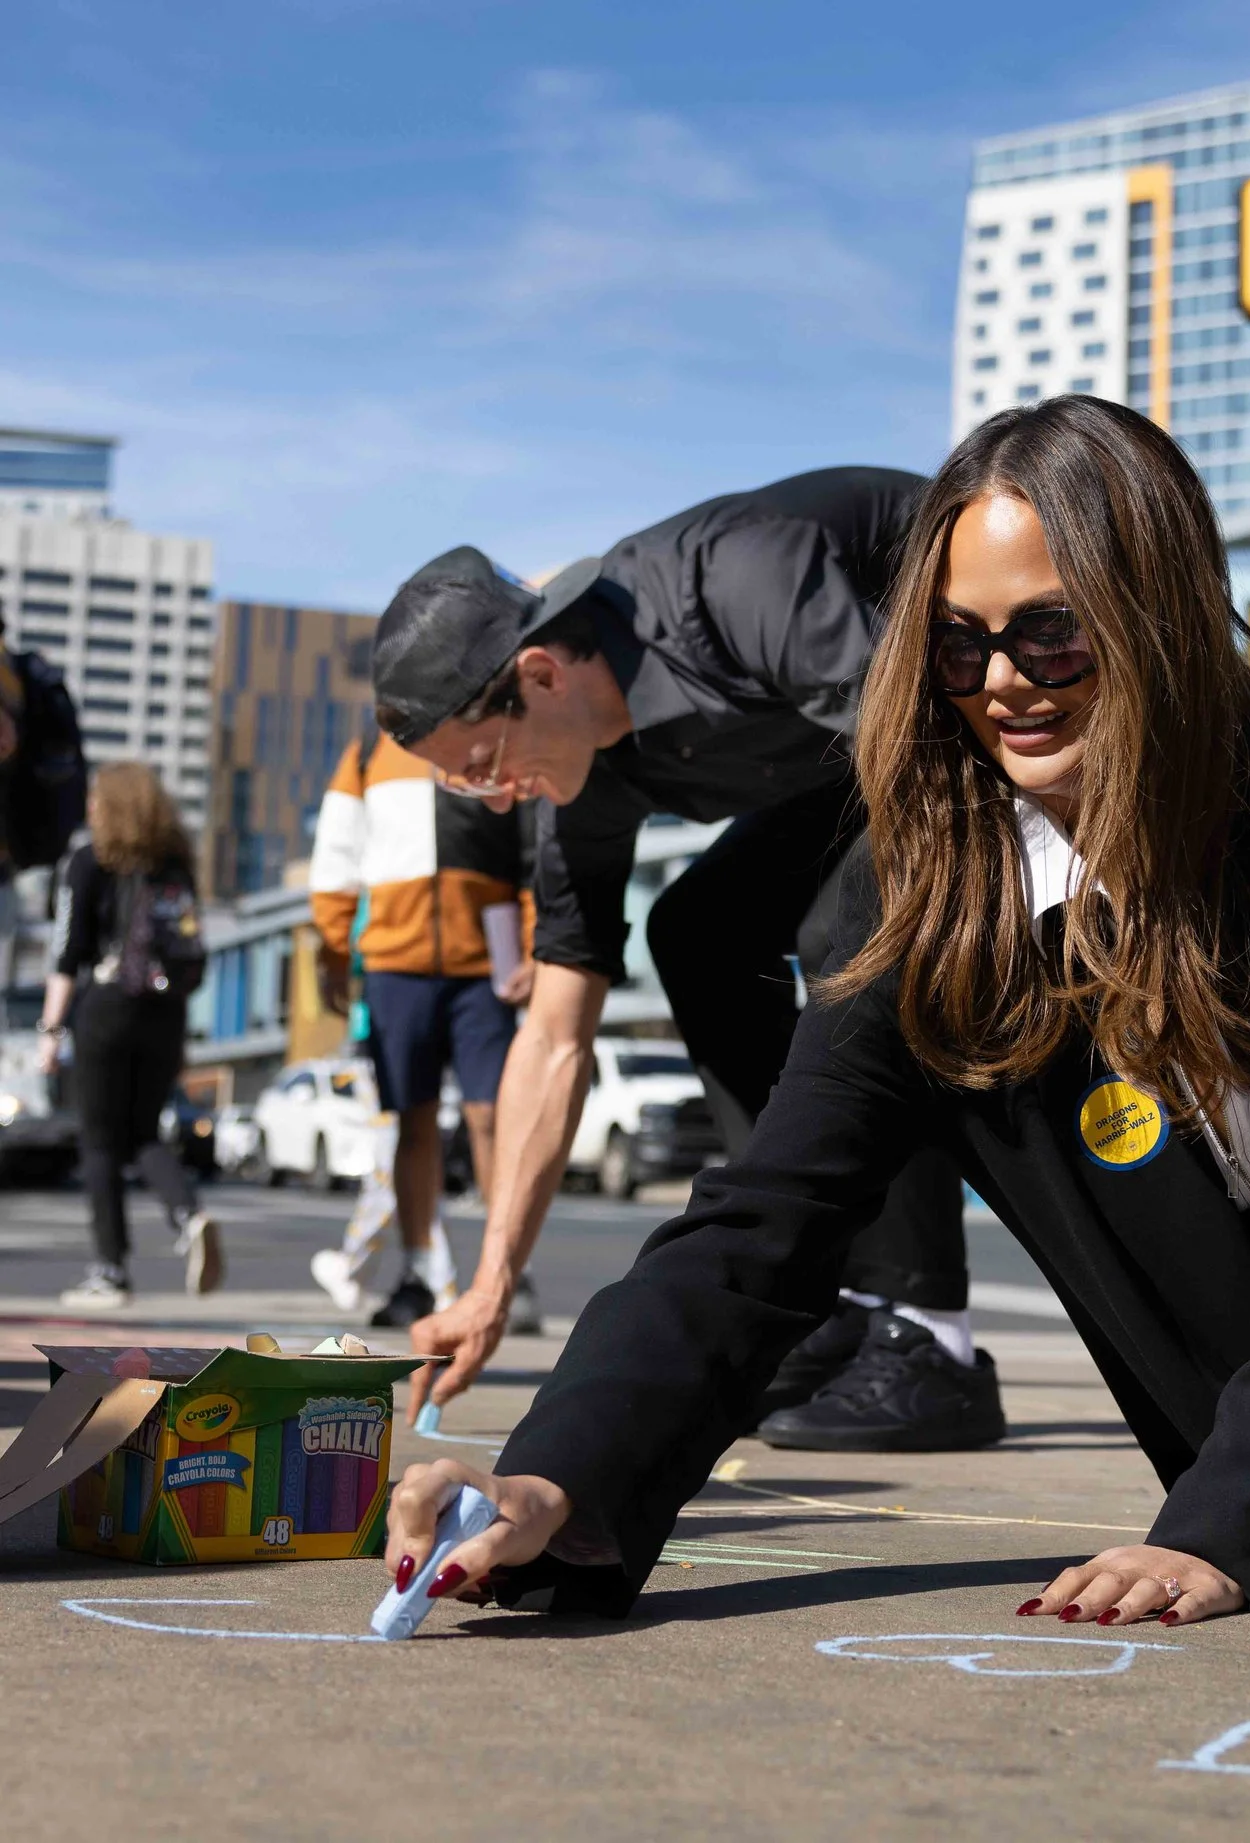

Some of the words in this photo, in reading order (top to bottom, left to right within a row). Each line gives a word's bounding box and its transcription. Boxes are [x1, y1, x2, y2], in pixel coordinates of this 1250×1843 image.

[1095, 1102, 1138, 1130] DRAGONS
[1111, 1116, 1130, 1130] FOR
[185, 1403, 229, 1421] Crayola
[311, 1411, 345, 1424] Washable
[346, 1410, 377, 1421] Sidewalk
[304, 1421, 383, 1457] CHALK
[208, 1455, 227, 1465] BOLD
[168, 1467, 206, 1486] CRAYOLA
[206, 1468, 236, 1479] COLORS
[97, 1515, 114, 1538] 48
[263, 1519, 290, 1545] 48
